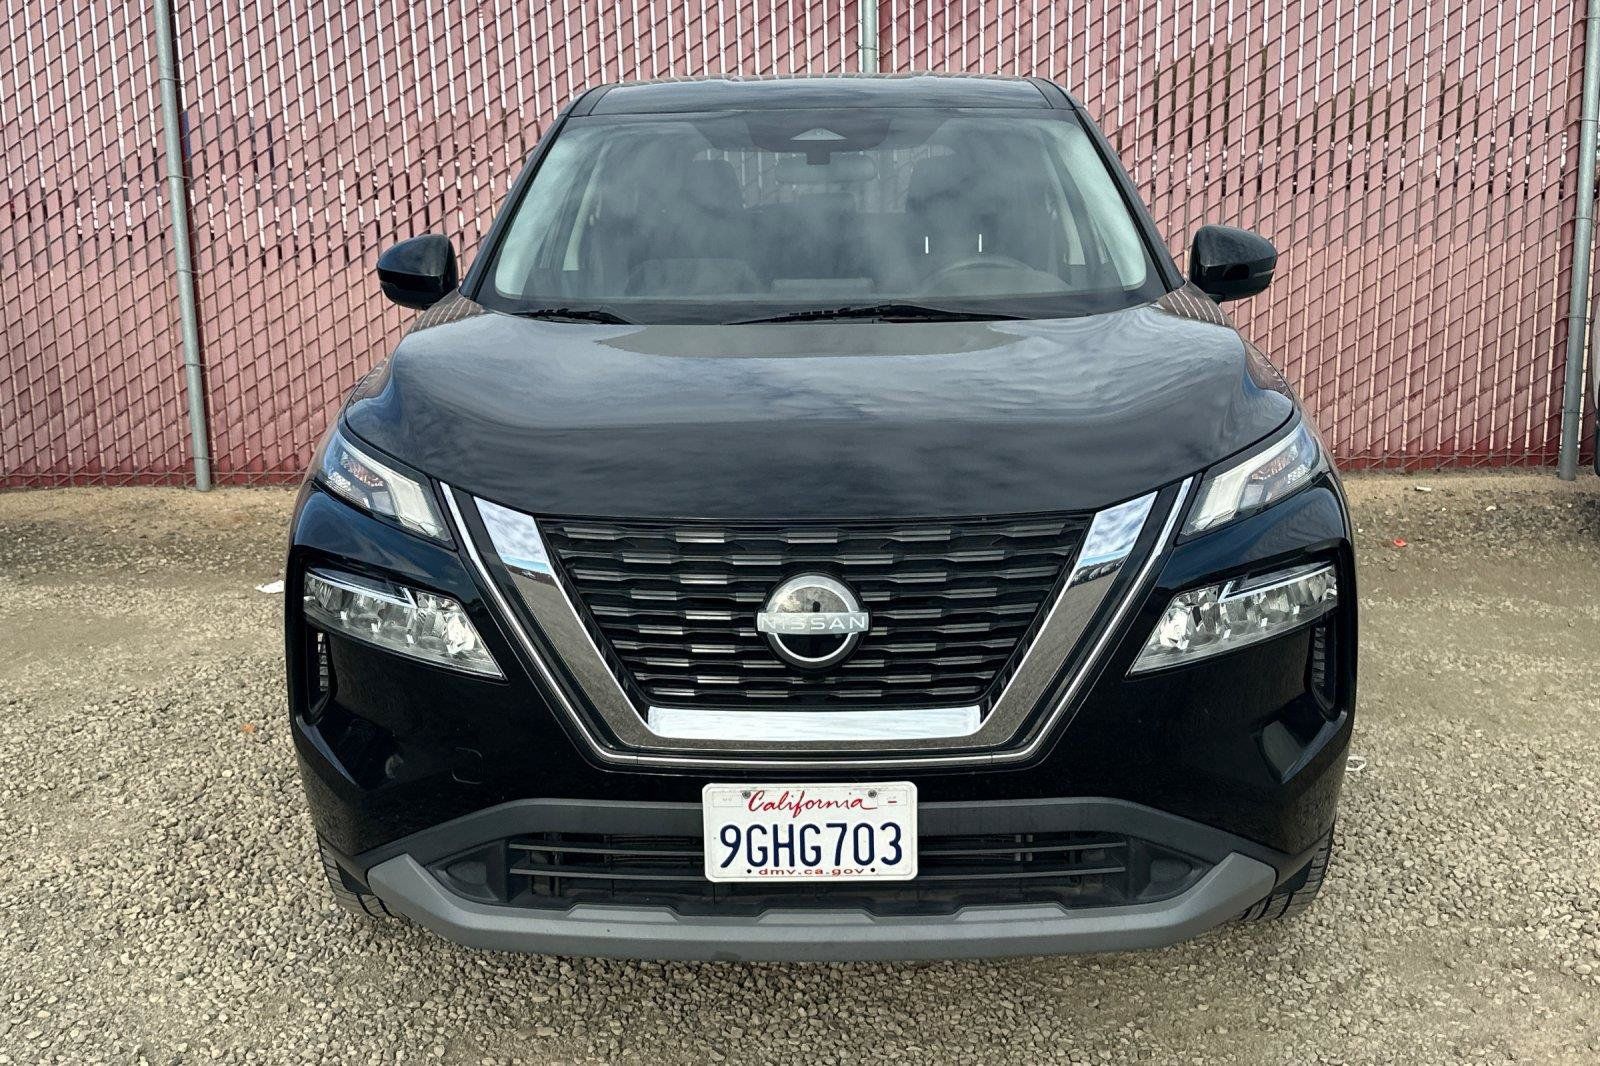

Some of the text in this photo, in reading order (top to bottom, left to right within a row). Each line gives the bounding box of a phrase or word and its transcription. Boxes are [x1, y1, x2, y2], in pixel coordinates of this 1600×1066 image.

[760, 615, 865, 630] NISSAN
[748, 790, 877, 818] California
[720, 822, 902, 868] 9GHG703
[758, 867, 864, 877] dmv.ca.gov
